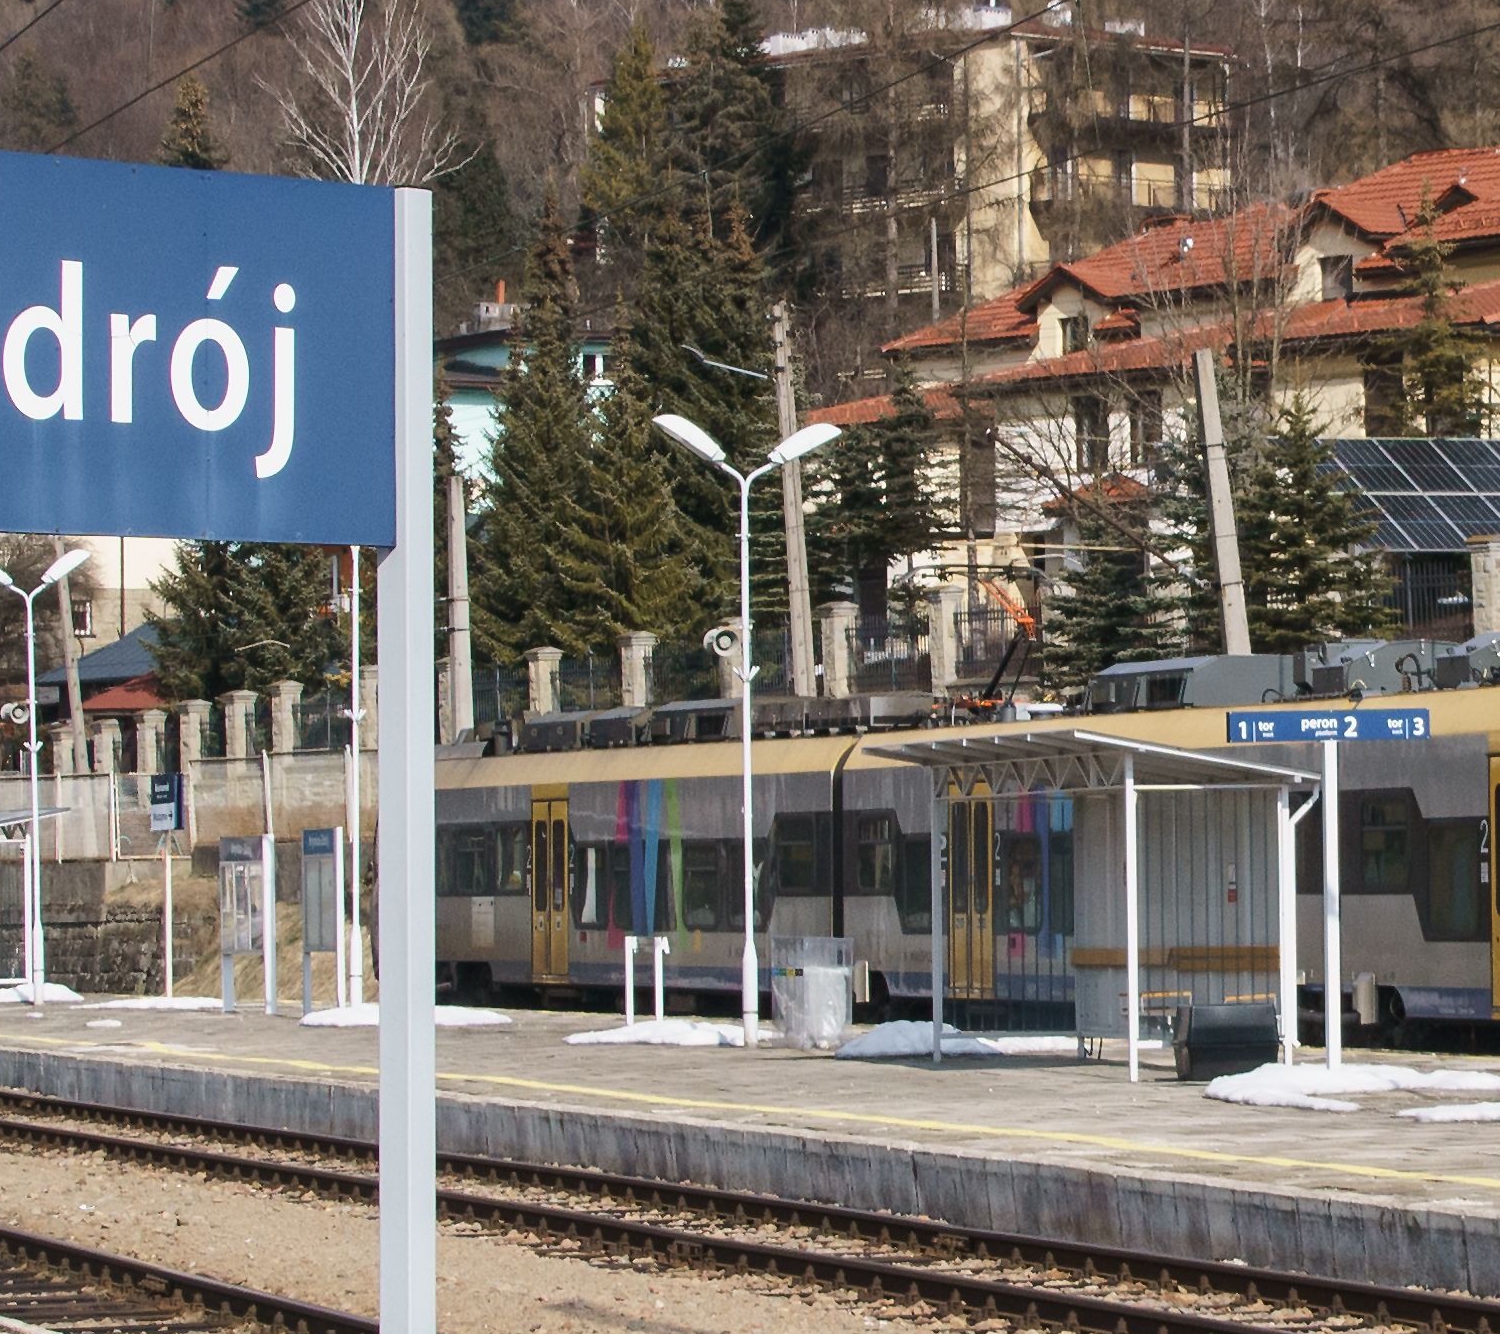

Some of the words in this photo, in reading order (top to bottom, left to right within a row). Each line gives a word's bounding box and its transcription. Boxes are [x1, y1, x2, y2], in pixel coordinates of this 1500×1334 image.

[1238, 720, 1248, 740] 1
[1258, 720, 1275, 732] tor
[1301, 717, 1338, 732] peron
[1343, 715, 1358, 738] 2
[1387, 718, 1403, 729] tor
[1412, 716, 1425, 736] 3
[1480, 818, 1489, 853] 2
